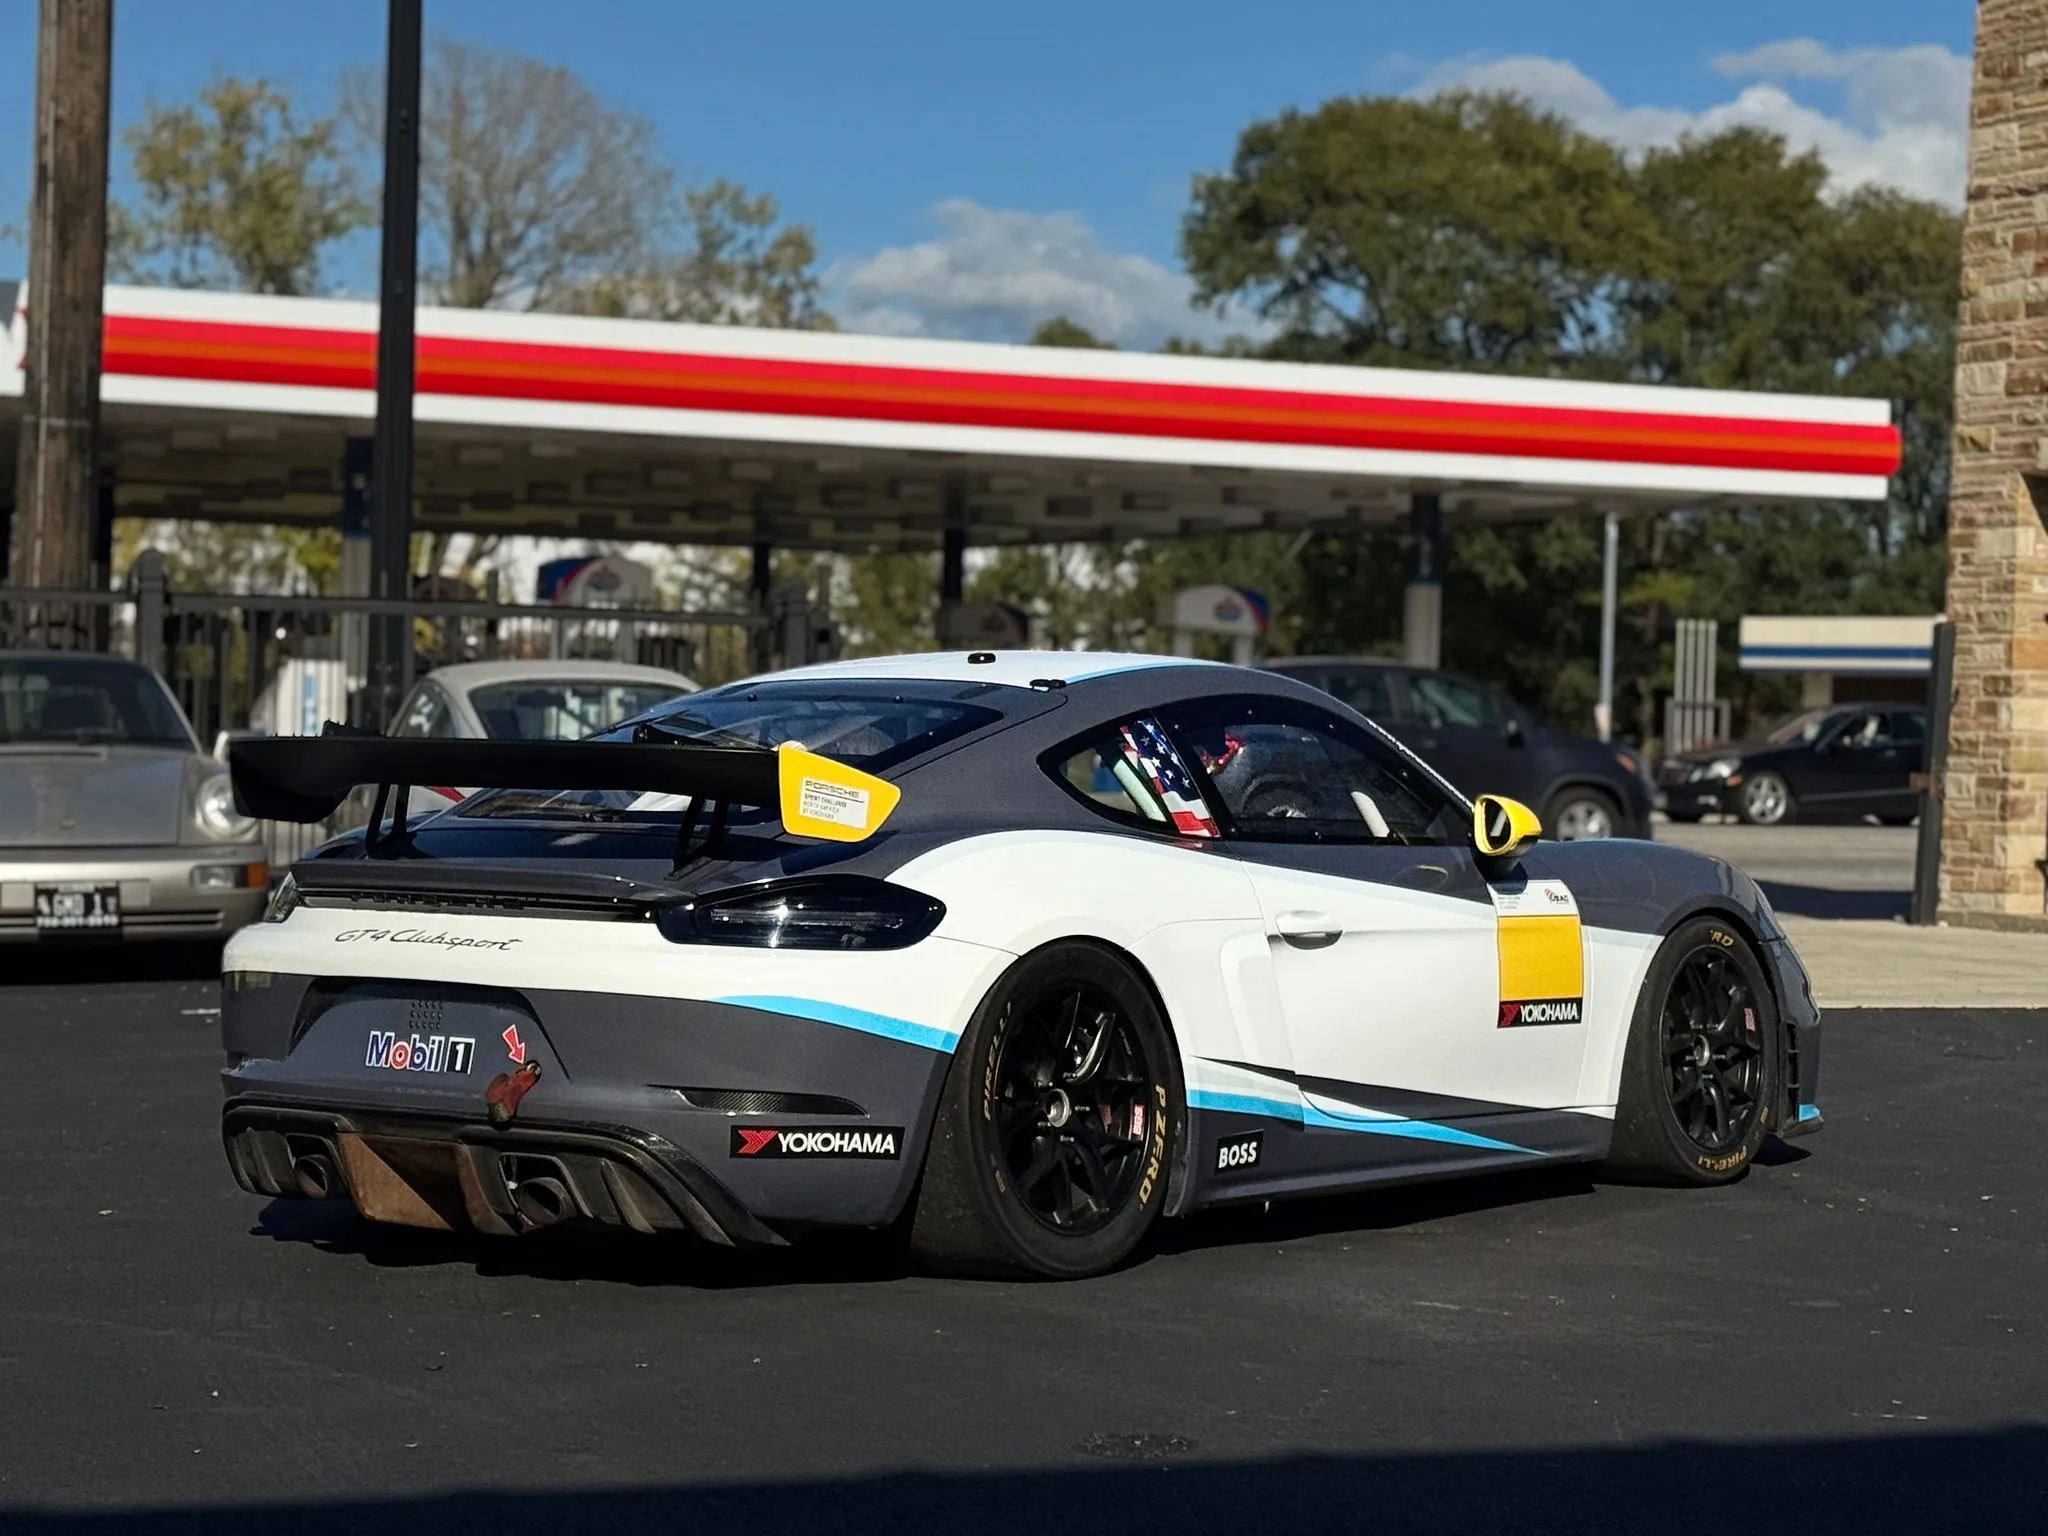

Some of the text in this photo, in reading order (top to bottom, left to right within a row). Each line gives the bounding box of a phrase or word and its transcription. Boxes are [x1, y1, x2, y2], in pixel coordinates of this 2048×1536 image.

[805, 780, 860, 798] PORSCHE
[335, 929, 523, 951] GT4 Clubsport
[1520, 1002, 1579, 1022] YOKOHAMA
[365, 1030, 445, 1073] Mobil
[1155, 1084, 1166, 1108] P
[778, 1132, 895, 1154] YOKOHAMA
[1139, 1110, 1166, 1205] ZERO
[1218, 1141, 1258, 1169] BOSS
